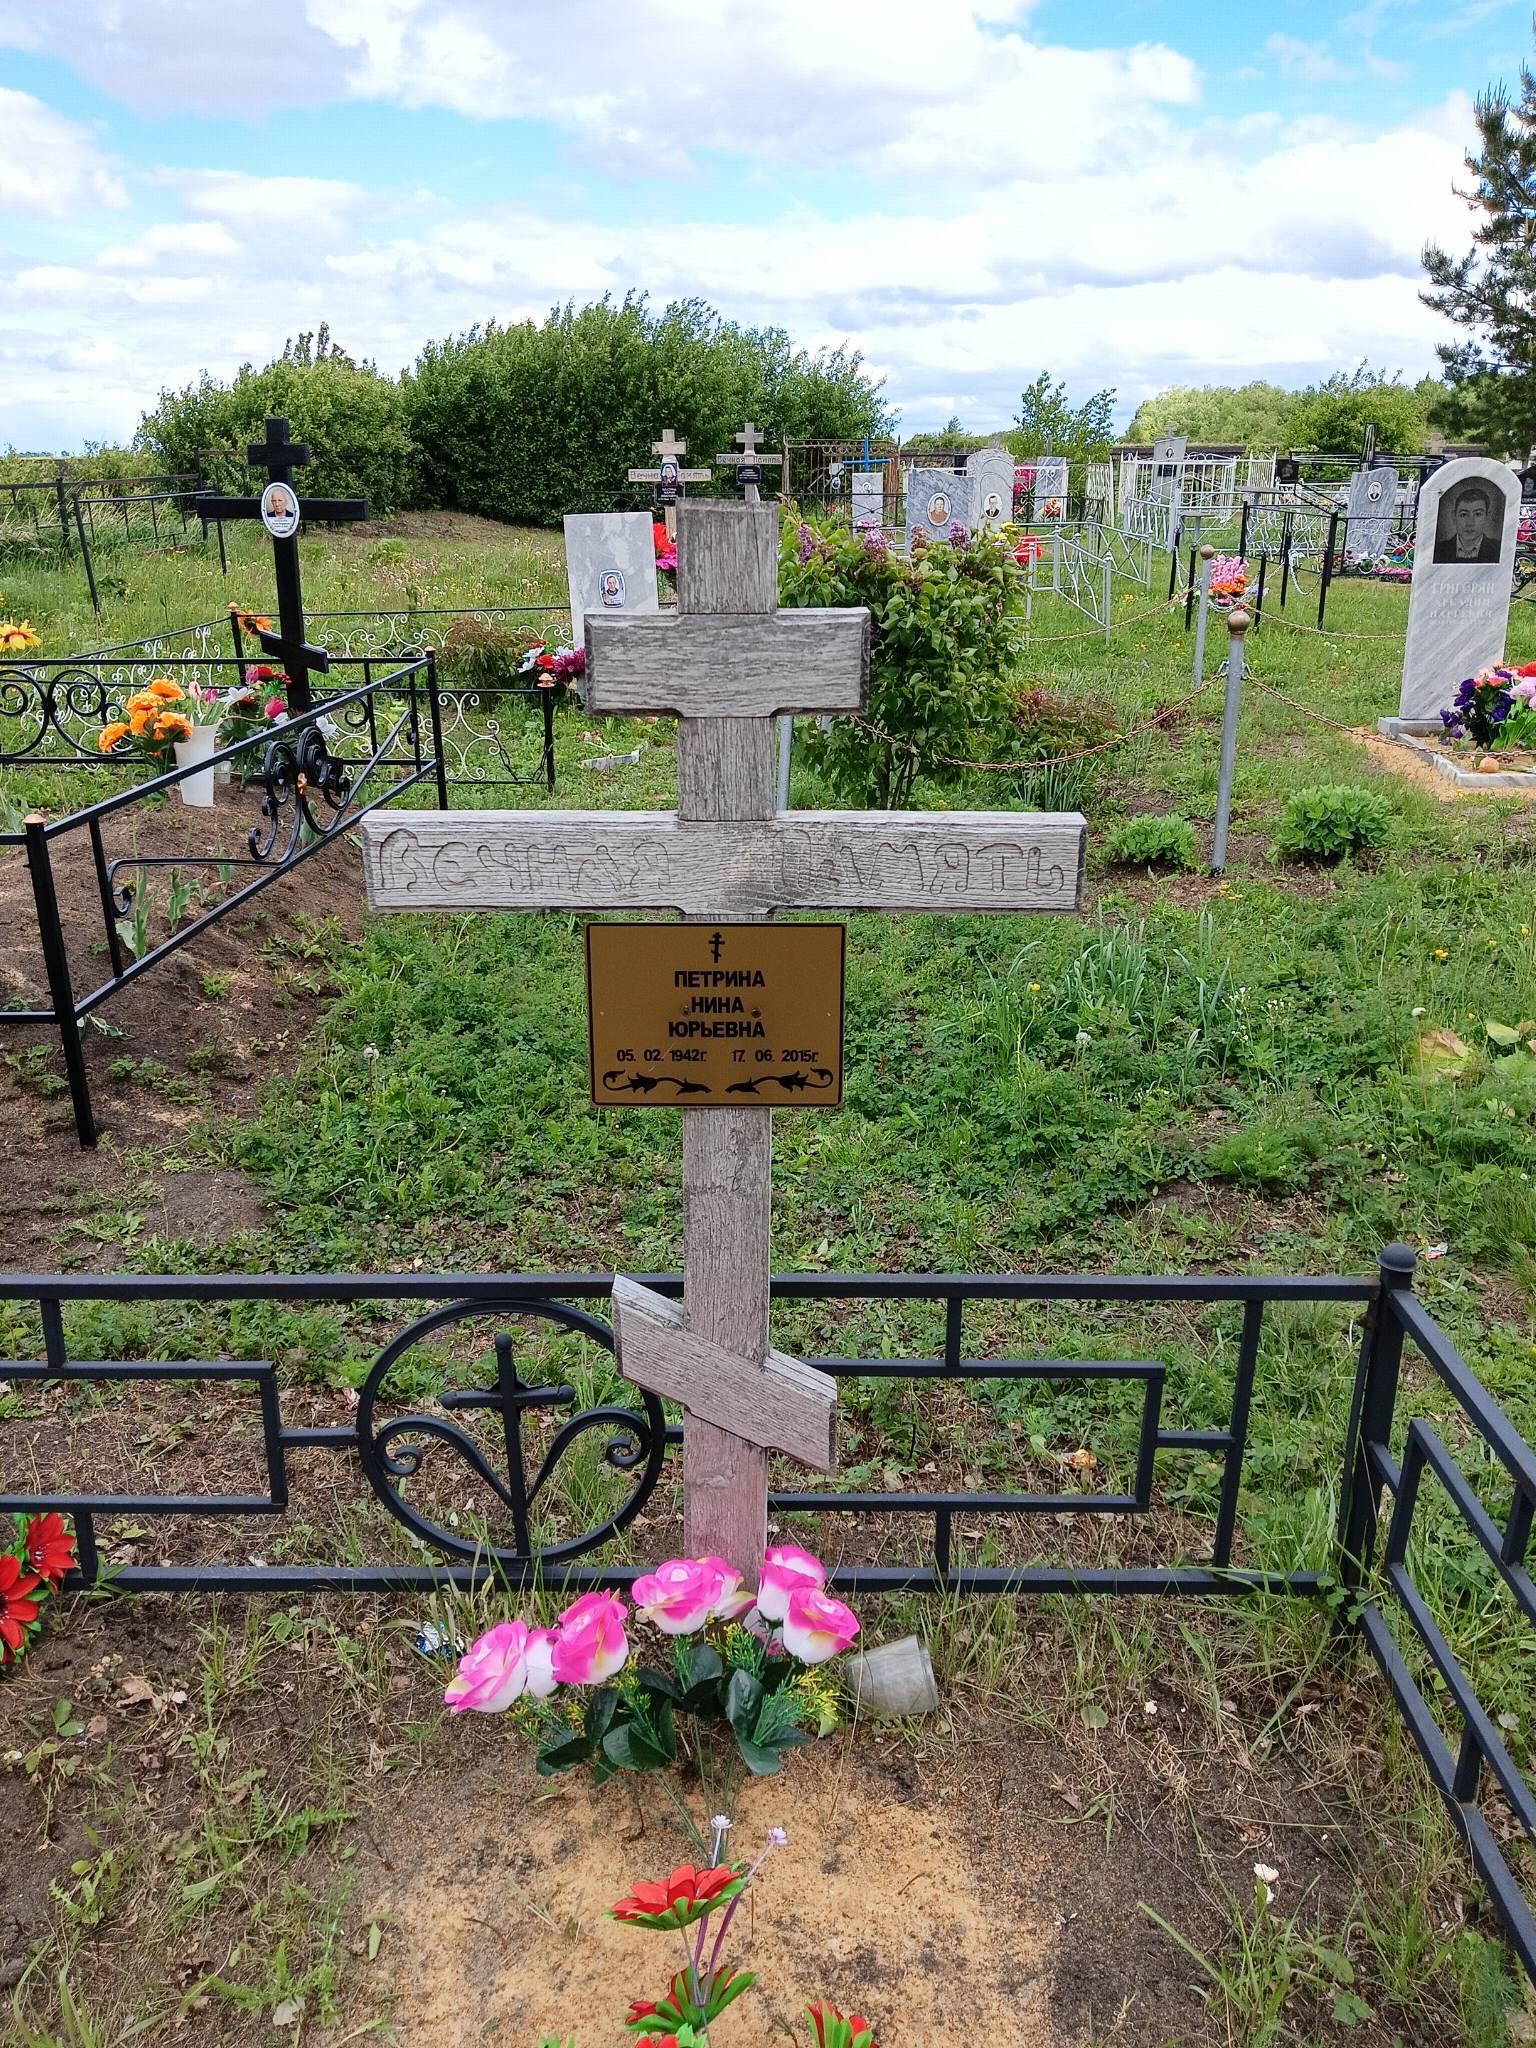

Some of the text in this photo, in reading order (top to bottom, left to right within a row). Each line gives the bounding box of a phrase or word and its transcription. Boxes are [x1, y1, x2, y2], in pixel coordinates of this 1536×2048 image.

[630, 471, 710, 480] Вечна амять
[379, 828, 672, 893] Вечная
[674, 970, 766, 988] ПЕТРИНА
[690, 996, 745, 1013] НИНА
[668, 1021, 766, 1038] ЮРЬЕВНА
[616, 1049, 819, 1063] 05. 02. 1942г. 17. 06. 2015г.
